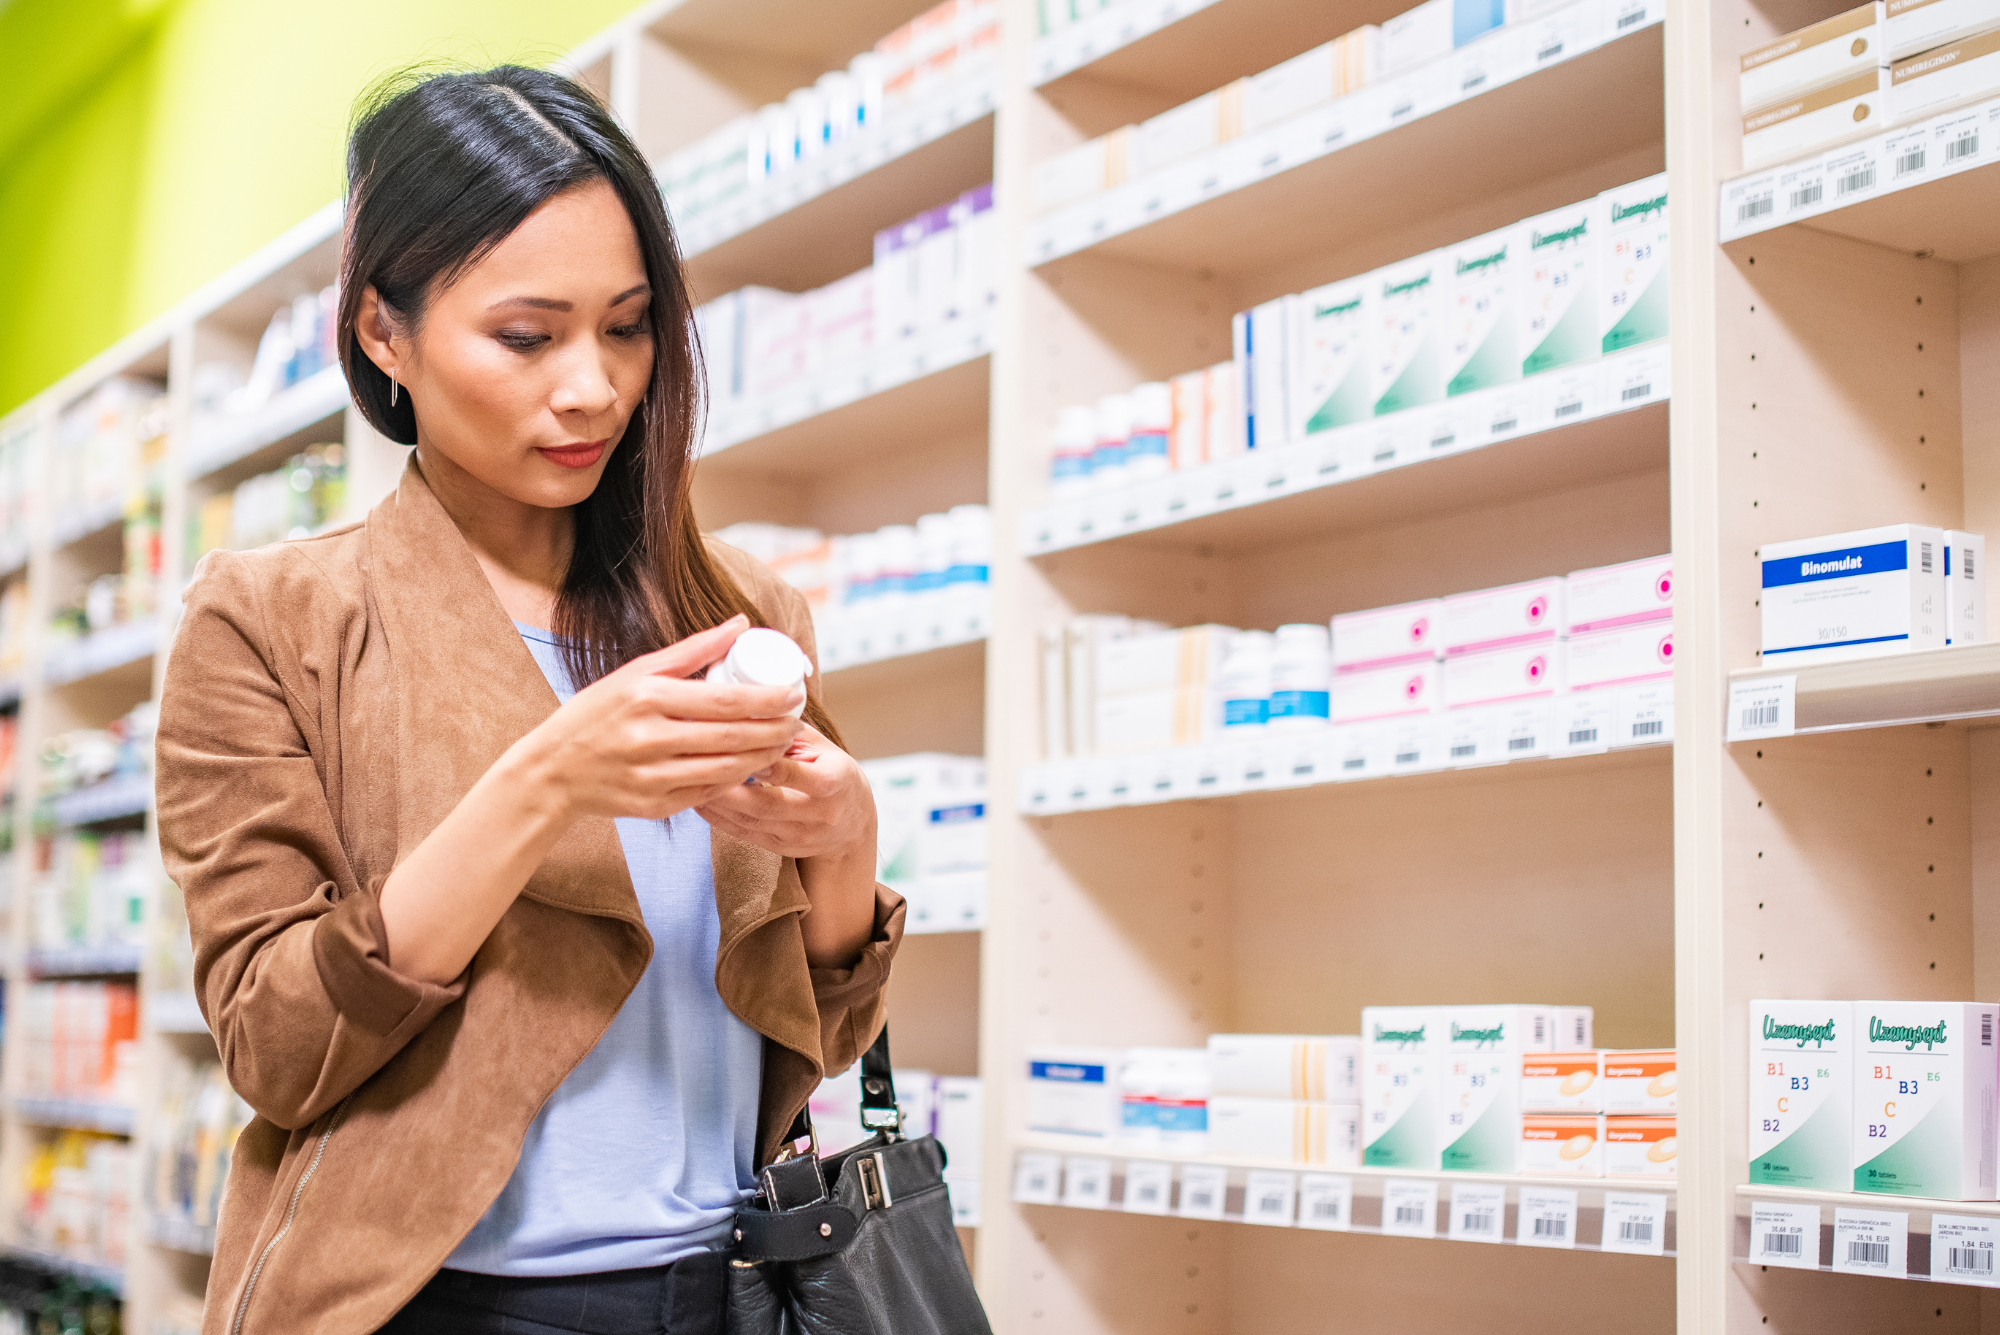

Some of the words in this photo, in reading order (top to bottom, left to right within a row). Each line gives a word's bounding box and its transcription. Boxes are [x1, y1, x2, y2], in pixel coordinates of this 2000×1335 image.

[1801, 555, 1862, 577] Binomulat
[1818, 625, 1848, 641] 30/150
[1763, 1015, 1835, 1048] Uzemysept
[1870, 1016, 1947, 1051] Uzemysept
[1767, 1063, 1785, 1076] B1
[1817, 1069, 1830, 1078] E6
[1874, 1066, 1893, 1079] B1
[1791, 1077, 1809, 1090] B3
[1927, 1072, 1941, 1082] E6
[1899, 1081, 1919, 1095] B3
[1778, 1097, 1788, 1112] C
[1885, 1102, 1896, 1117] C
[1763, 1120, 1780, 1132] B2
[1869, 1125, 1887, 1138] B2
[1868, 1169, 1877, 1178] 30
[1857, 1234, 1873, 1242] 35,16
[1876, 1235, 1890, 1243] EUR
[1962, 1240, 1975, 1248] 1,84
[1979, 1241, 1994, 1249] EUR
